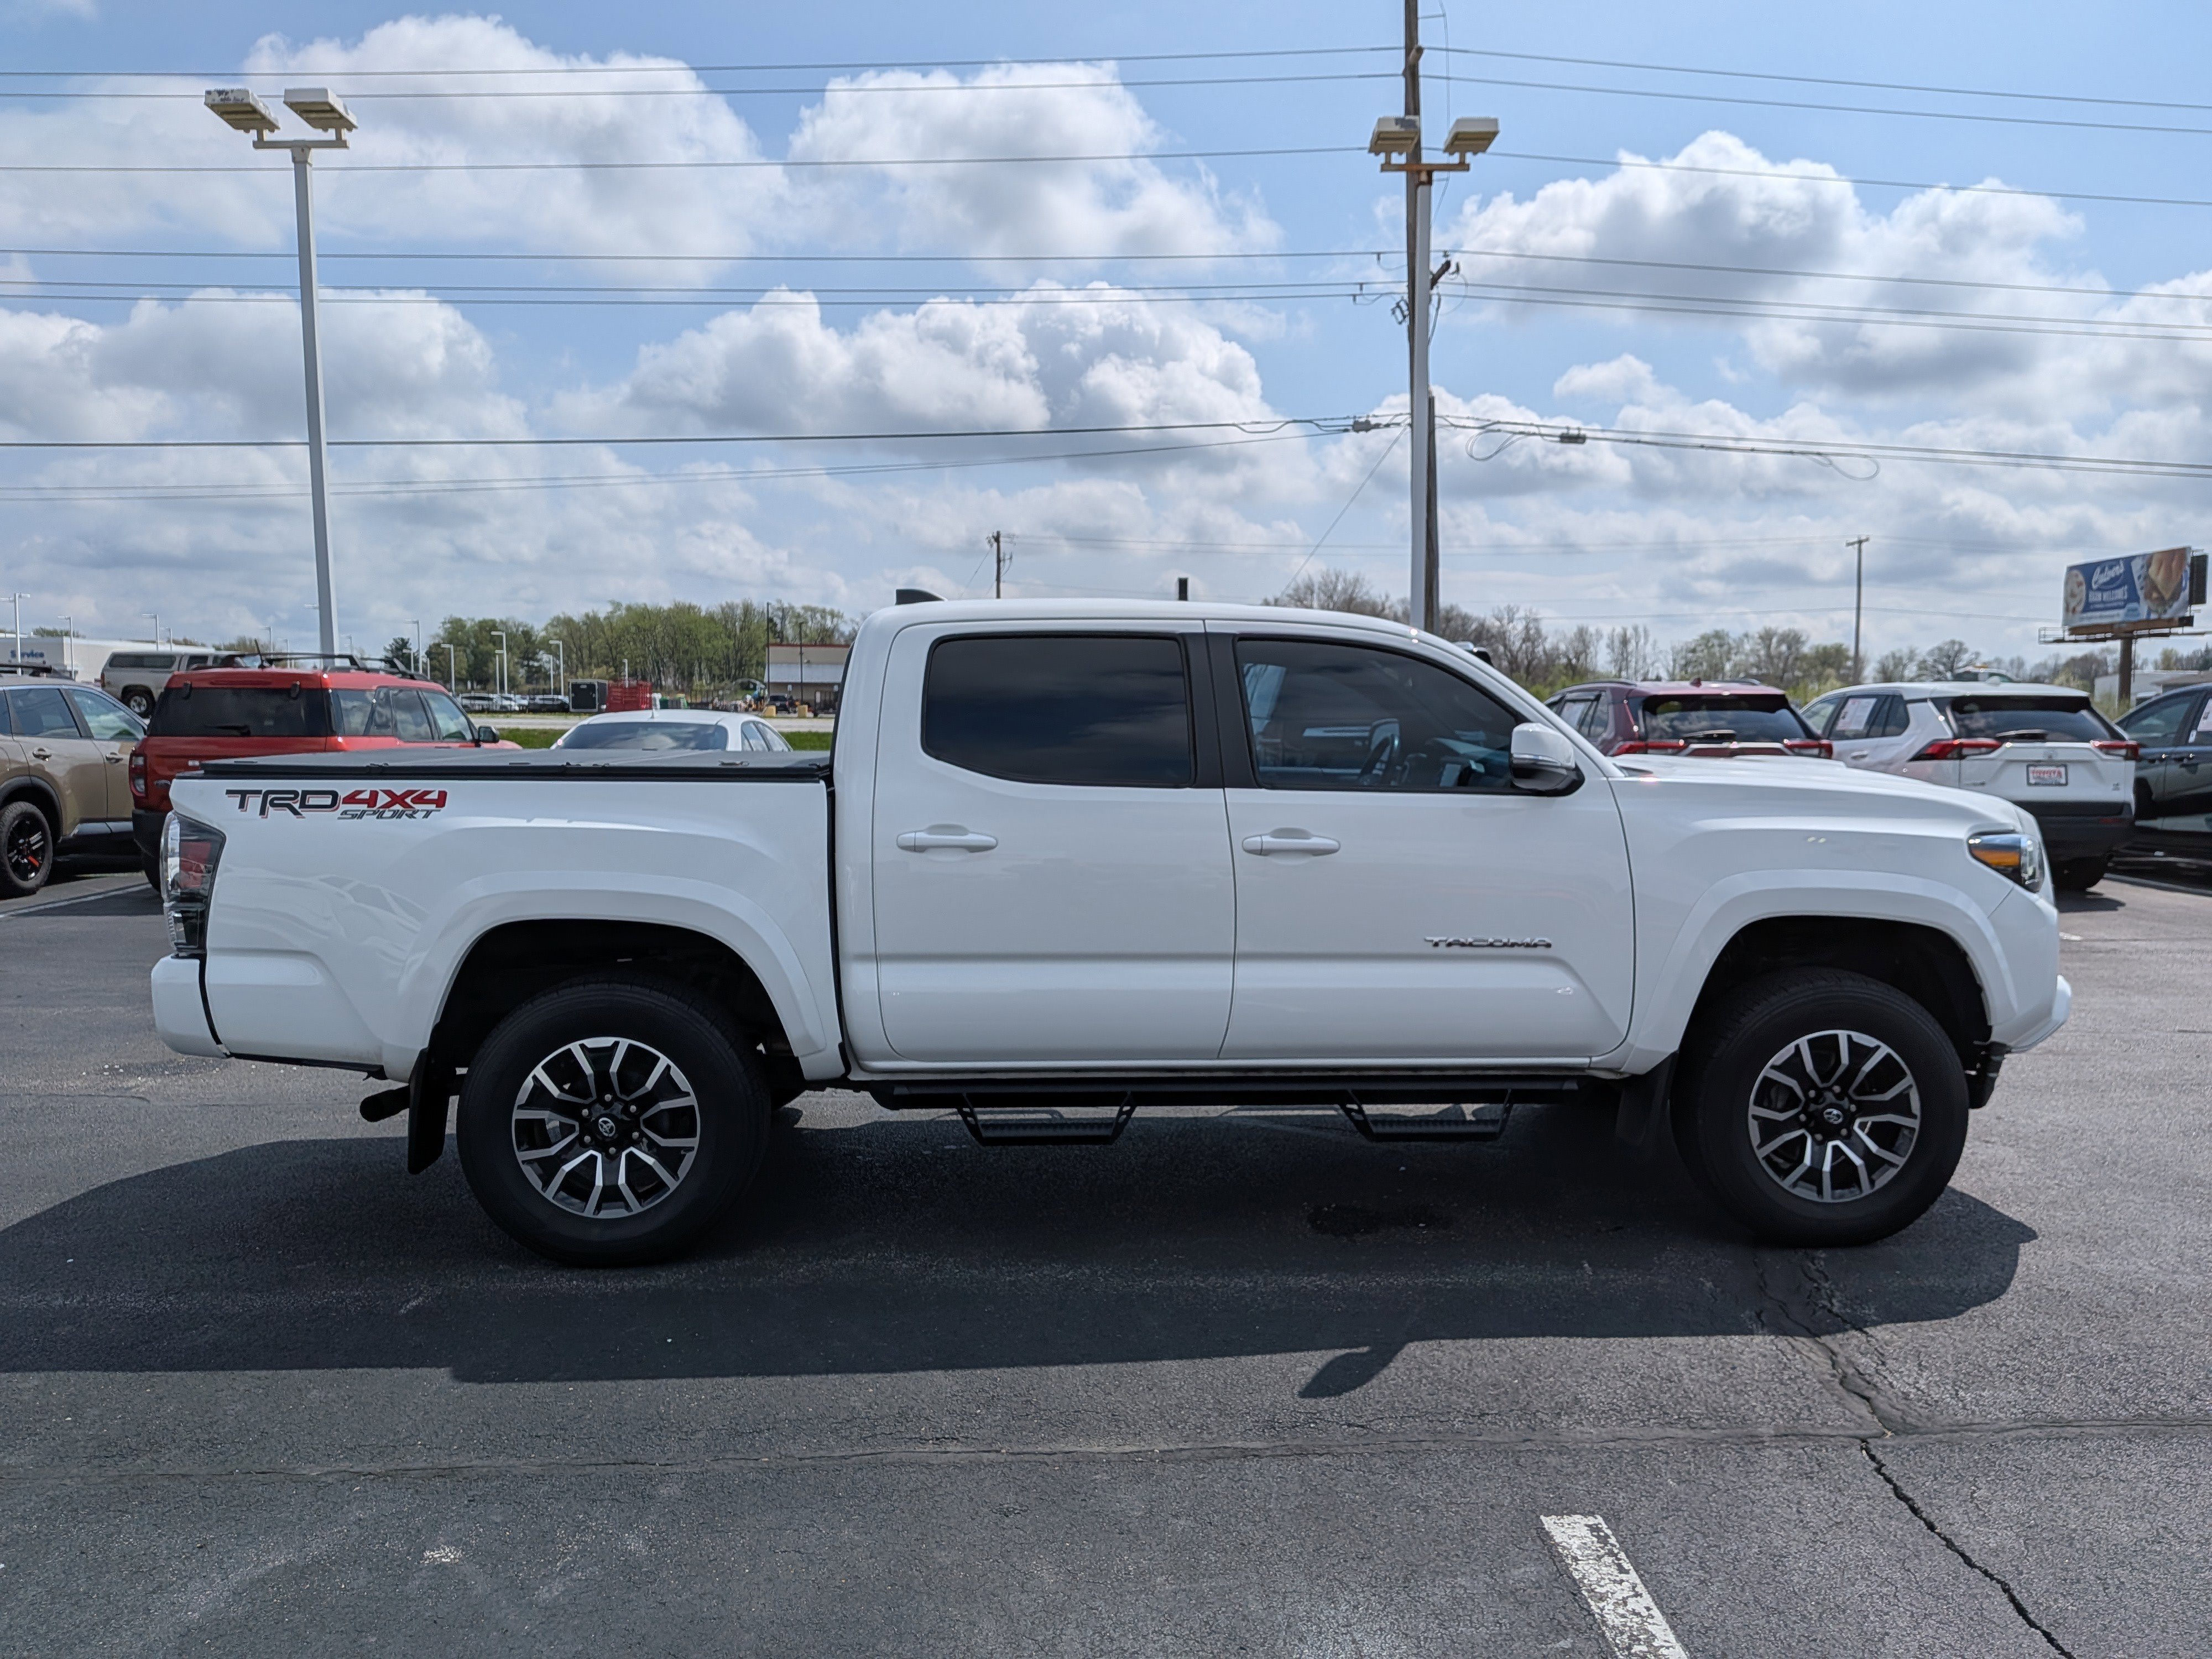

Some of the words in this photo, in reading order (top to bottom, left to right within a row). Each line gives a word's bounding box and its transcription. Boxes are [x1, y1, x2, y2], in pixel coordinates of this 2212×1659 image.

[11, 649, 45, 658] Srvice
[337, 809, 441, 820] SPORT
[1424, 935, 1552, 948] TACOMA
